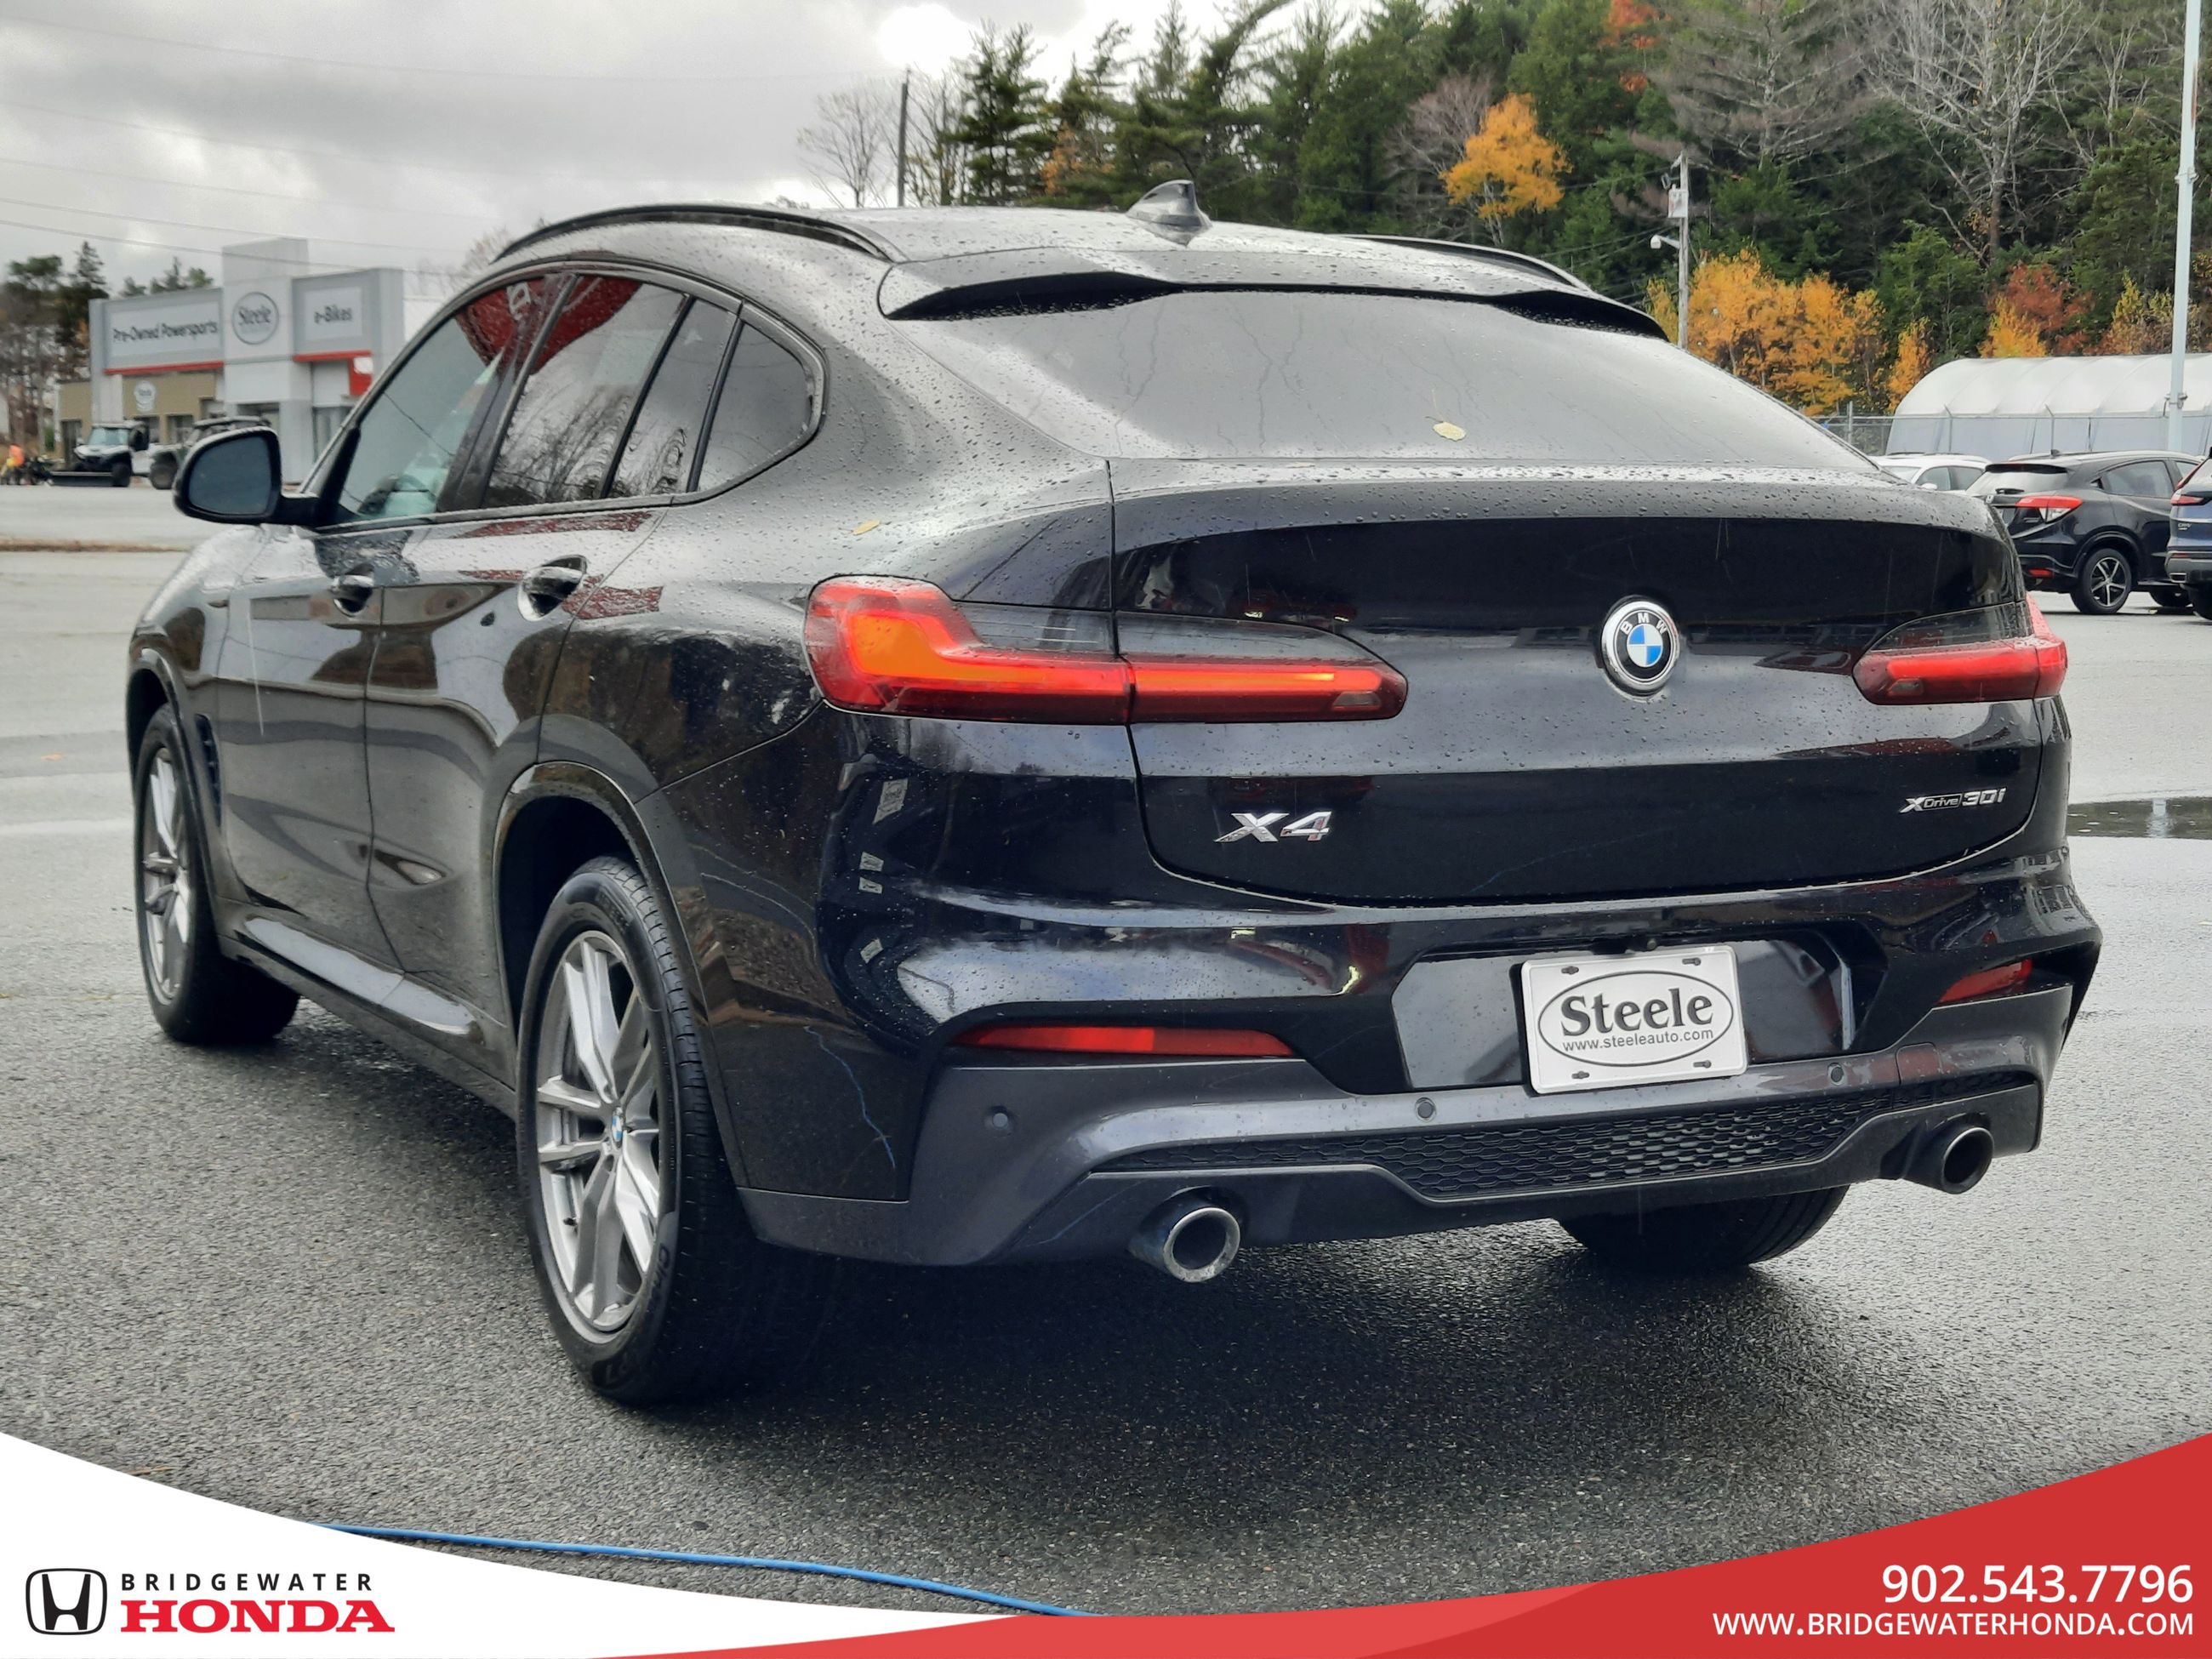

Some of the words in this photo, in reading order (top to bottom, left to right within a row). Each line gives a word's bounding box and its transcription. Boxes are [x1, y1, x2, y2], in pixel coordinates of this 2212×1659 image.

[238, 305, 271, 326] Steele
[1620, 612, 1668, 636] BMW
[1214, 811, 1332, 842] X4
[1559, 987, 1713, 1037] Steele
[1562, 1028, 1713, 1052] www.steeleauto.com
